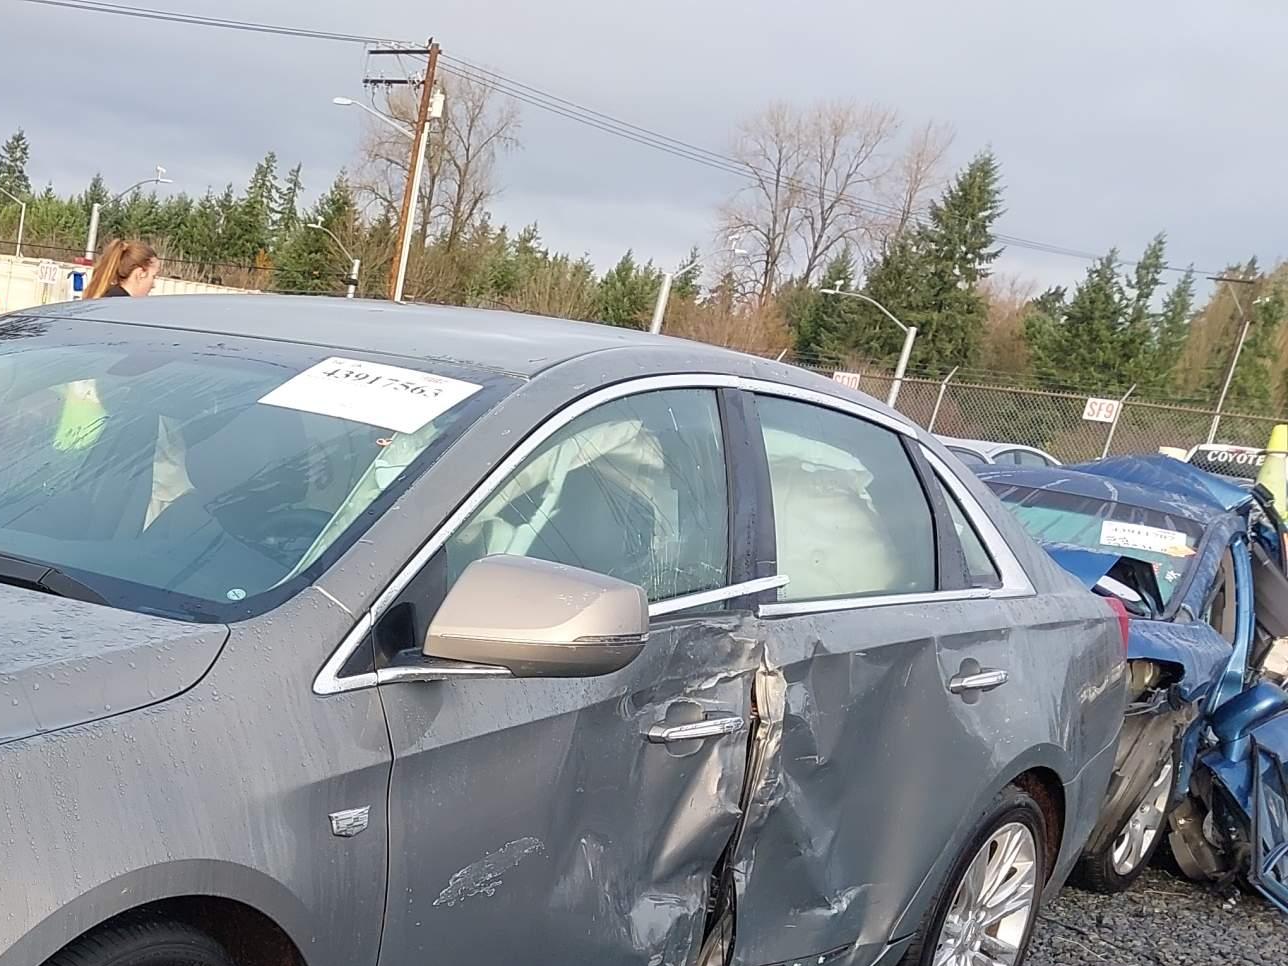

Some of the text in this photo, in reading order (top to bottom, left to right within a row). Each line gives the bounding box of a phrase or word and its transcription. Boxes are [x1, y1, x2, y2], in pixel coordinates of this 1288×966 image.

[39, 265, 57, 281] SF12
[321, 367, 444, 399] 43917563
[1087, 401, 1114, 418] SF9
[1207, 450, 1266, 466] COYOTE
